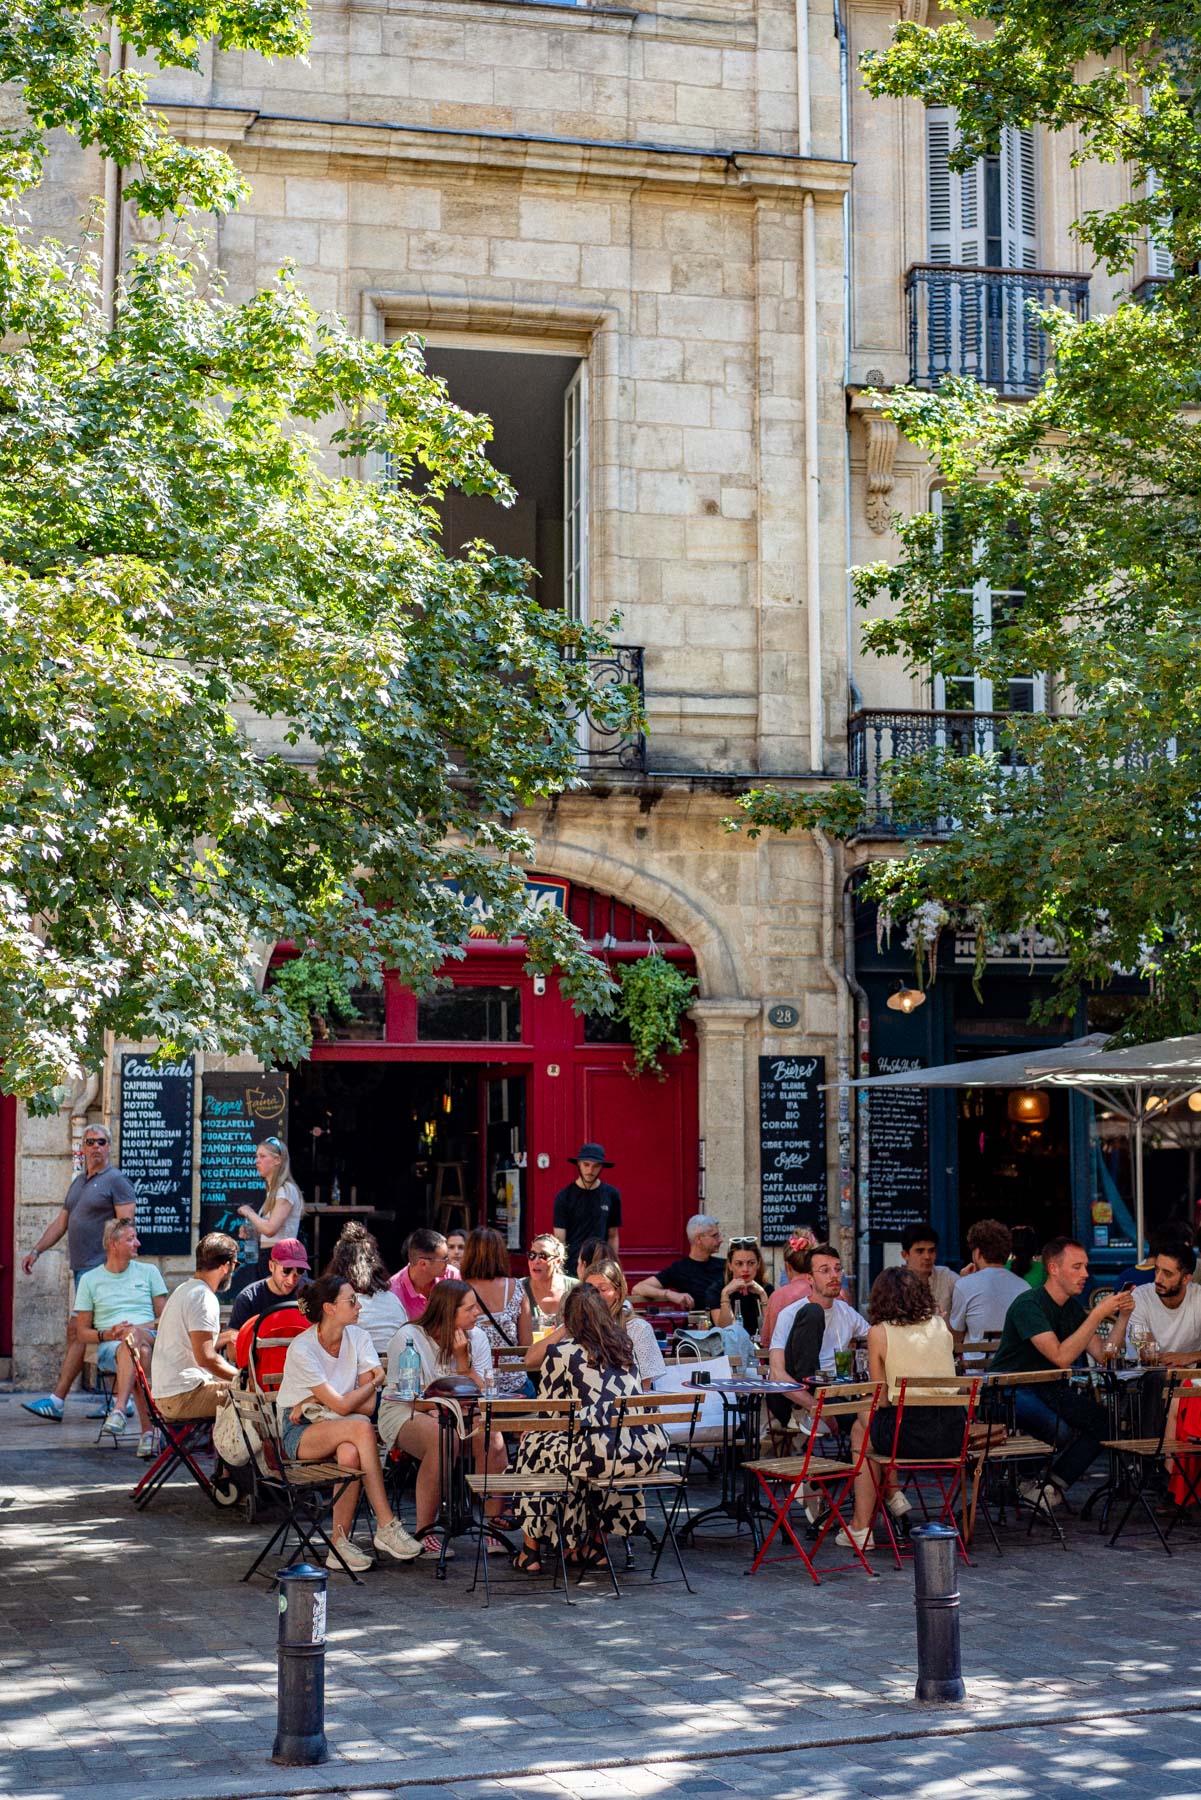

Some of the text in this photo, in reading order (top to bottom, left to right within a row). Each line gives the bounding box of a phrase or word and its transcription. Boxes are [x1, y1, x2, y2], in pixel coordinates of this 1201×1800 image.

[776, 1009, 792, 1023] 28
[770, 1058, 818, 1081] Bières
[123, 1081, 163, 1090] CAIPIRINHA
[781, 1082, 806, 1090] BLONDE
[123, 1091, 131, 1099] TI
[132, 1091, 158, 1099] PUNCH
[779, 1091, 808, 1099] BLANCHE
[123, 1101, 155, 1109] MOJITO
[205, 1095, 243, 1115] Pizzas
[786, 1101, 799, 1109] IPA
[123, 1111, 137, 1119] GIN
[138, 1111, 162, 1119] TONIC
[785, 1111, 800, 1119] BIO
[123, 1120, 144, 1128] CUBA
[144, 1120, 166, 1128] LIBRE
[202, 1119, 255, 1128] MOZZARELLA
[762, 1121, 798, 1129] CORONA
[122, 1130, 191, 1138] WHITE RUSSIAN 9
[202, 1132, 252, 1140] FUGAZETTA
[122, 1140, 152, 1148] BLOODY
[152, 1140, 174, 1148] MARY
[201, 1144, 231, 1152] JAMON
[236, 1144, 258, 1152] MORR
[762, 1141, 783, 1149] CIDRE
[784, 1140, 811, 1148] POMME
[122, 1149, 191, 1157] MAI THAI 10
[144, 1159, 173, 1167] ISLAND
[182, 1159, 191, 1167] 10
[774, 1151, 810, 1170] Softs
[201, 1169, 260, 1178] VEGETARIANA
[763, 1173, 784, 1181] CAFE
[201, 1181, 228, 1189] PIZZA
[762, 1184, 784, 1192] CAFE
[763, 1195, 784, 1203] SIROP
[135, 1206, 151, 1214] NET
[154, 1206, 177, 1214] COCA
[763, 1205, 797, 1213] DIABOLO
[154, 1215, 180, 1223] SPRITZ
[763, 1215, 784, 1223] SOFT
[136, 1225, 152, 1233] TINI
[152, 1225, 173, 1233] FIERO
